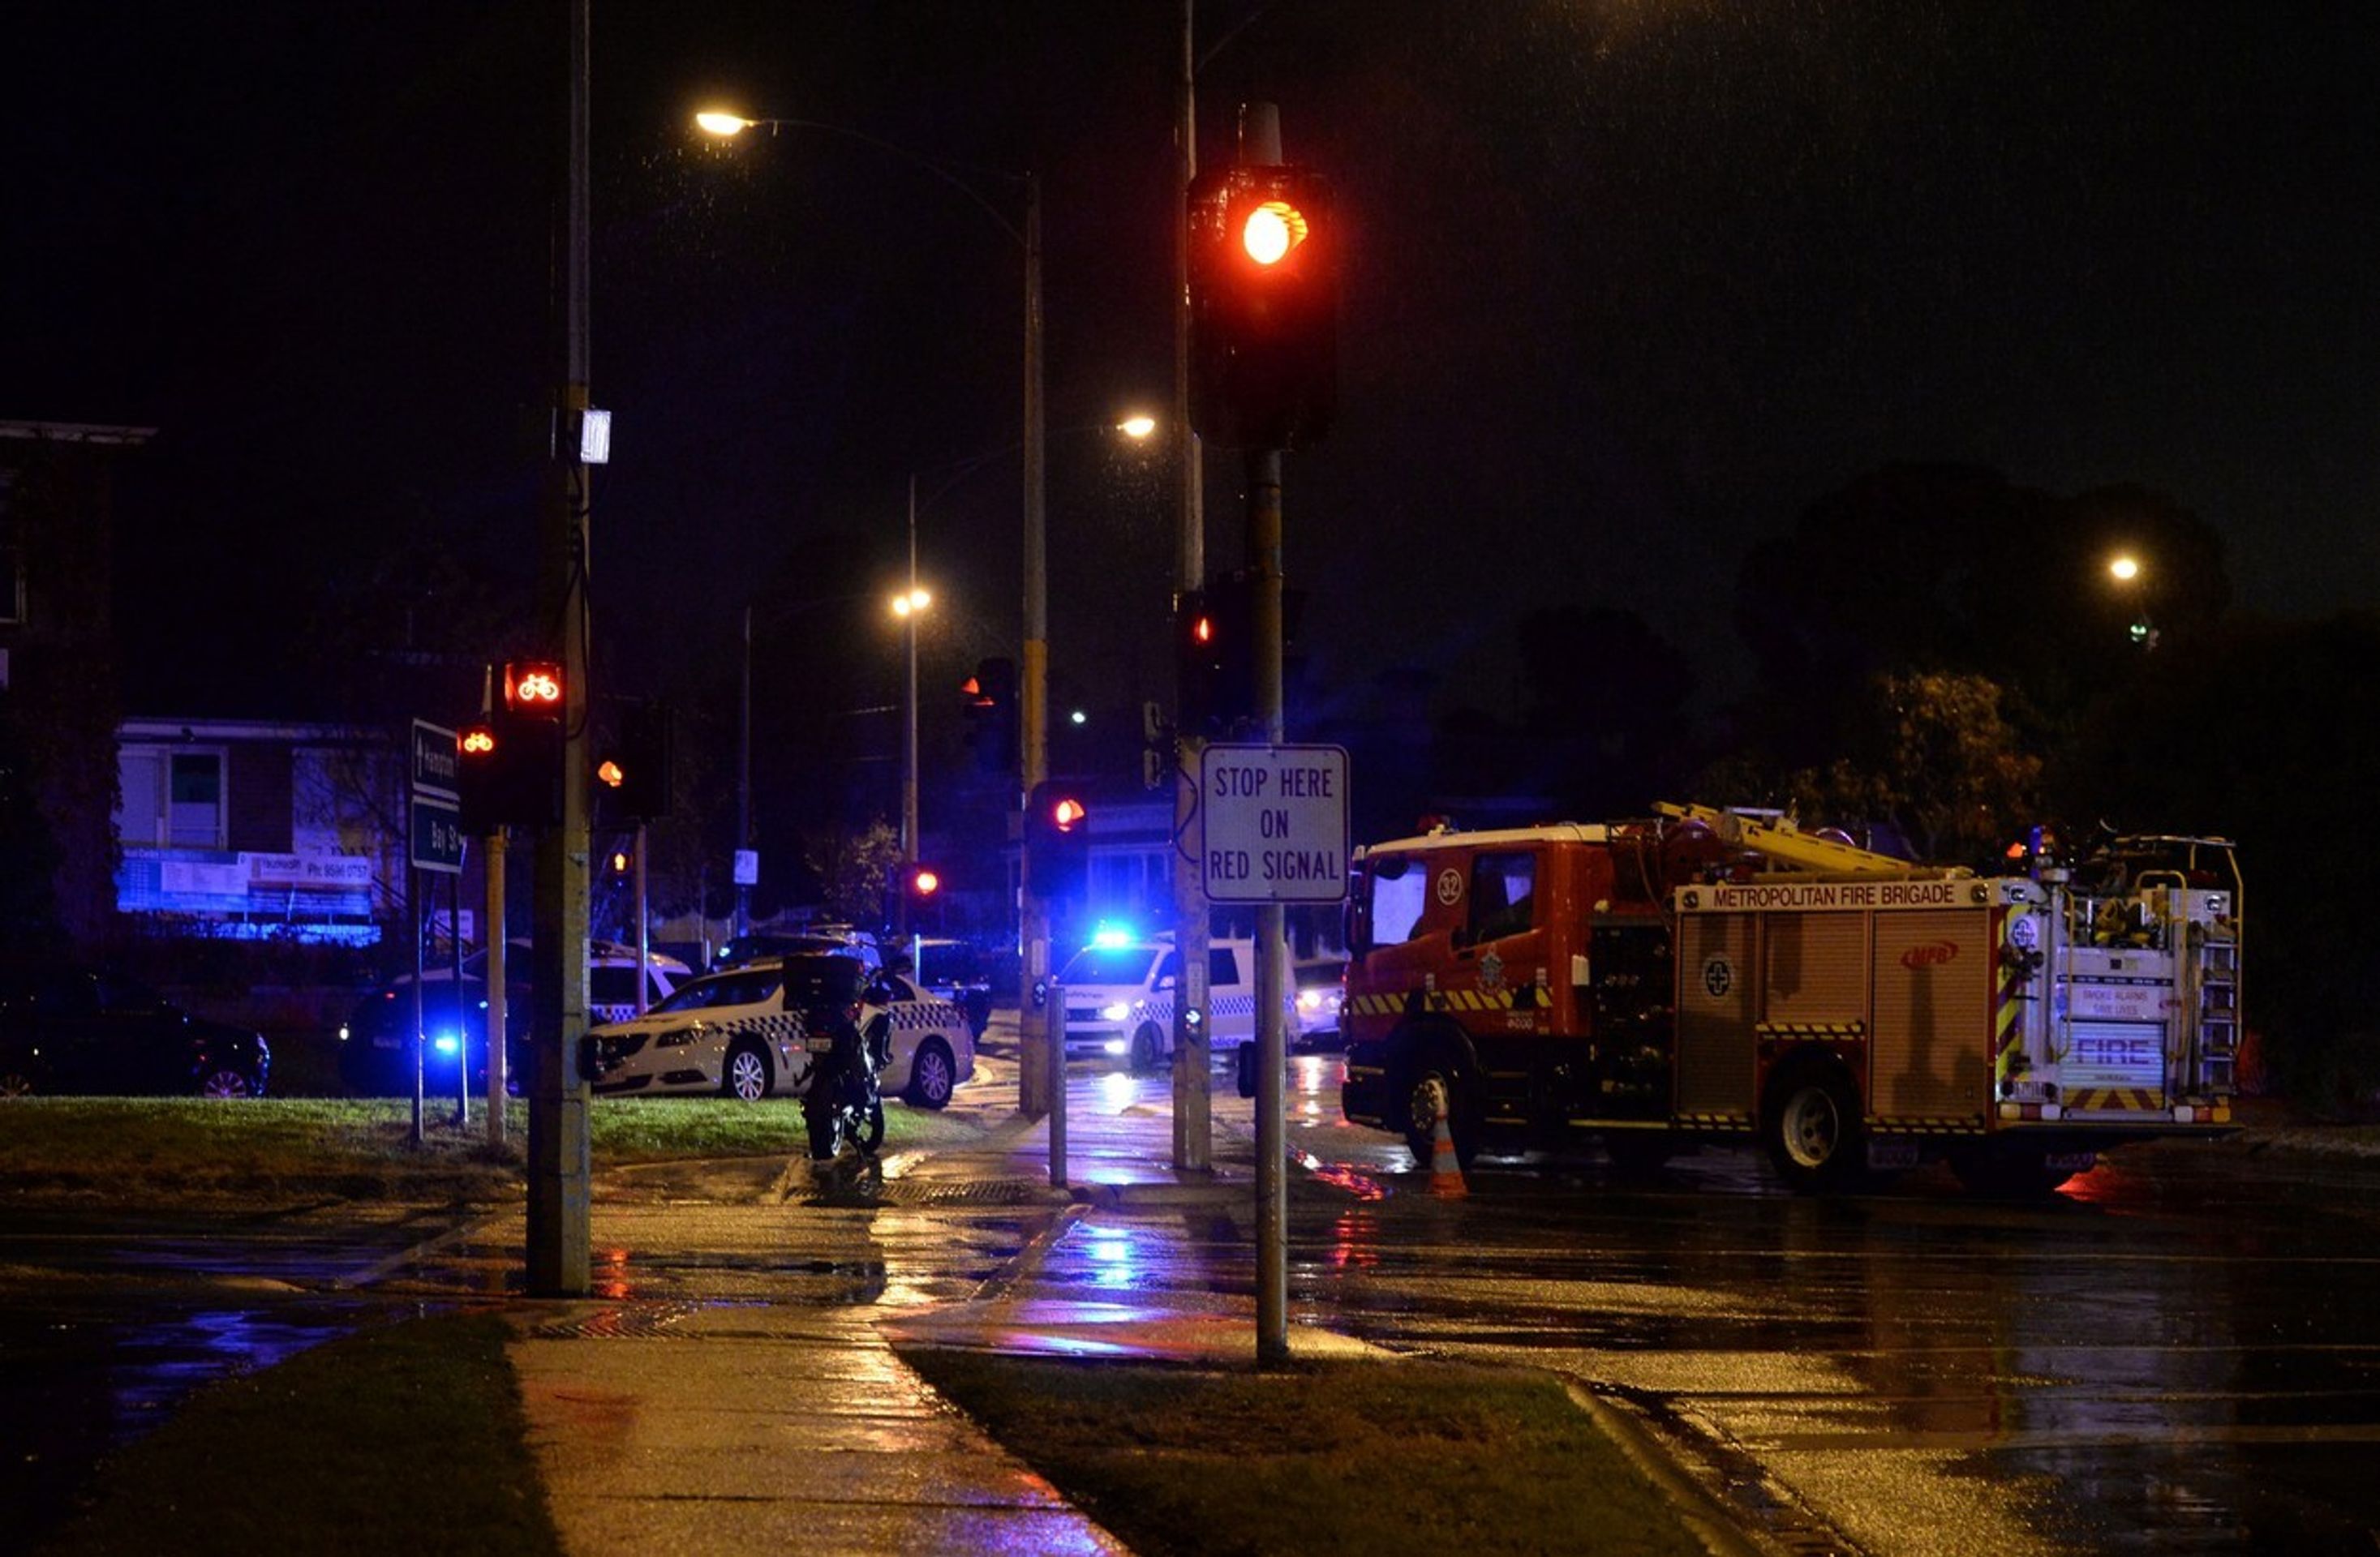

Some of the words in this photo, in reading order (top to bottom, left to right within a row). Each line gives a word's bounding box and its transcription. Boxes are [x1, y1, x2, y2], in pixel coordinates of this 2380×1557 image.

[1215, 767, 1268, 797] STOP
[1280, 768, 1333, 797] HERE
[431, 819, 446, 857] Bay
[1261, 809, 1289, 839] ON
[1210, 851, 1249, 880] RED
[1263, 851, 1339, 881] SIGNAL
[1441, 875, 1458, 897] 32
[1714, 887, 1836, 907] METROPOLITAN
[1841, 886, 1876, 905] FIRE
[1882, 884, 1954, 904] BRIGADE
[2077, 1039, 2150, 1065] FIRE
